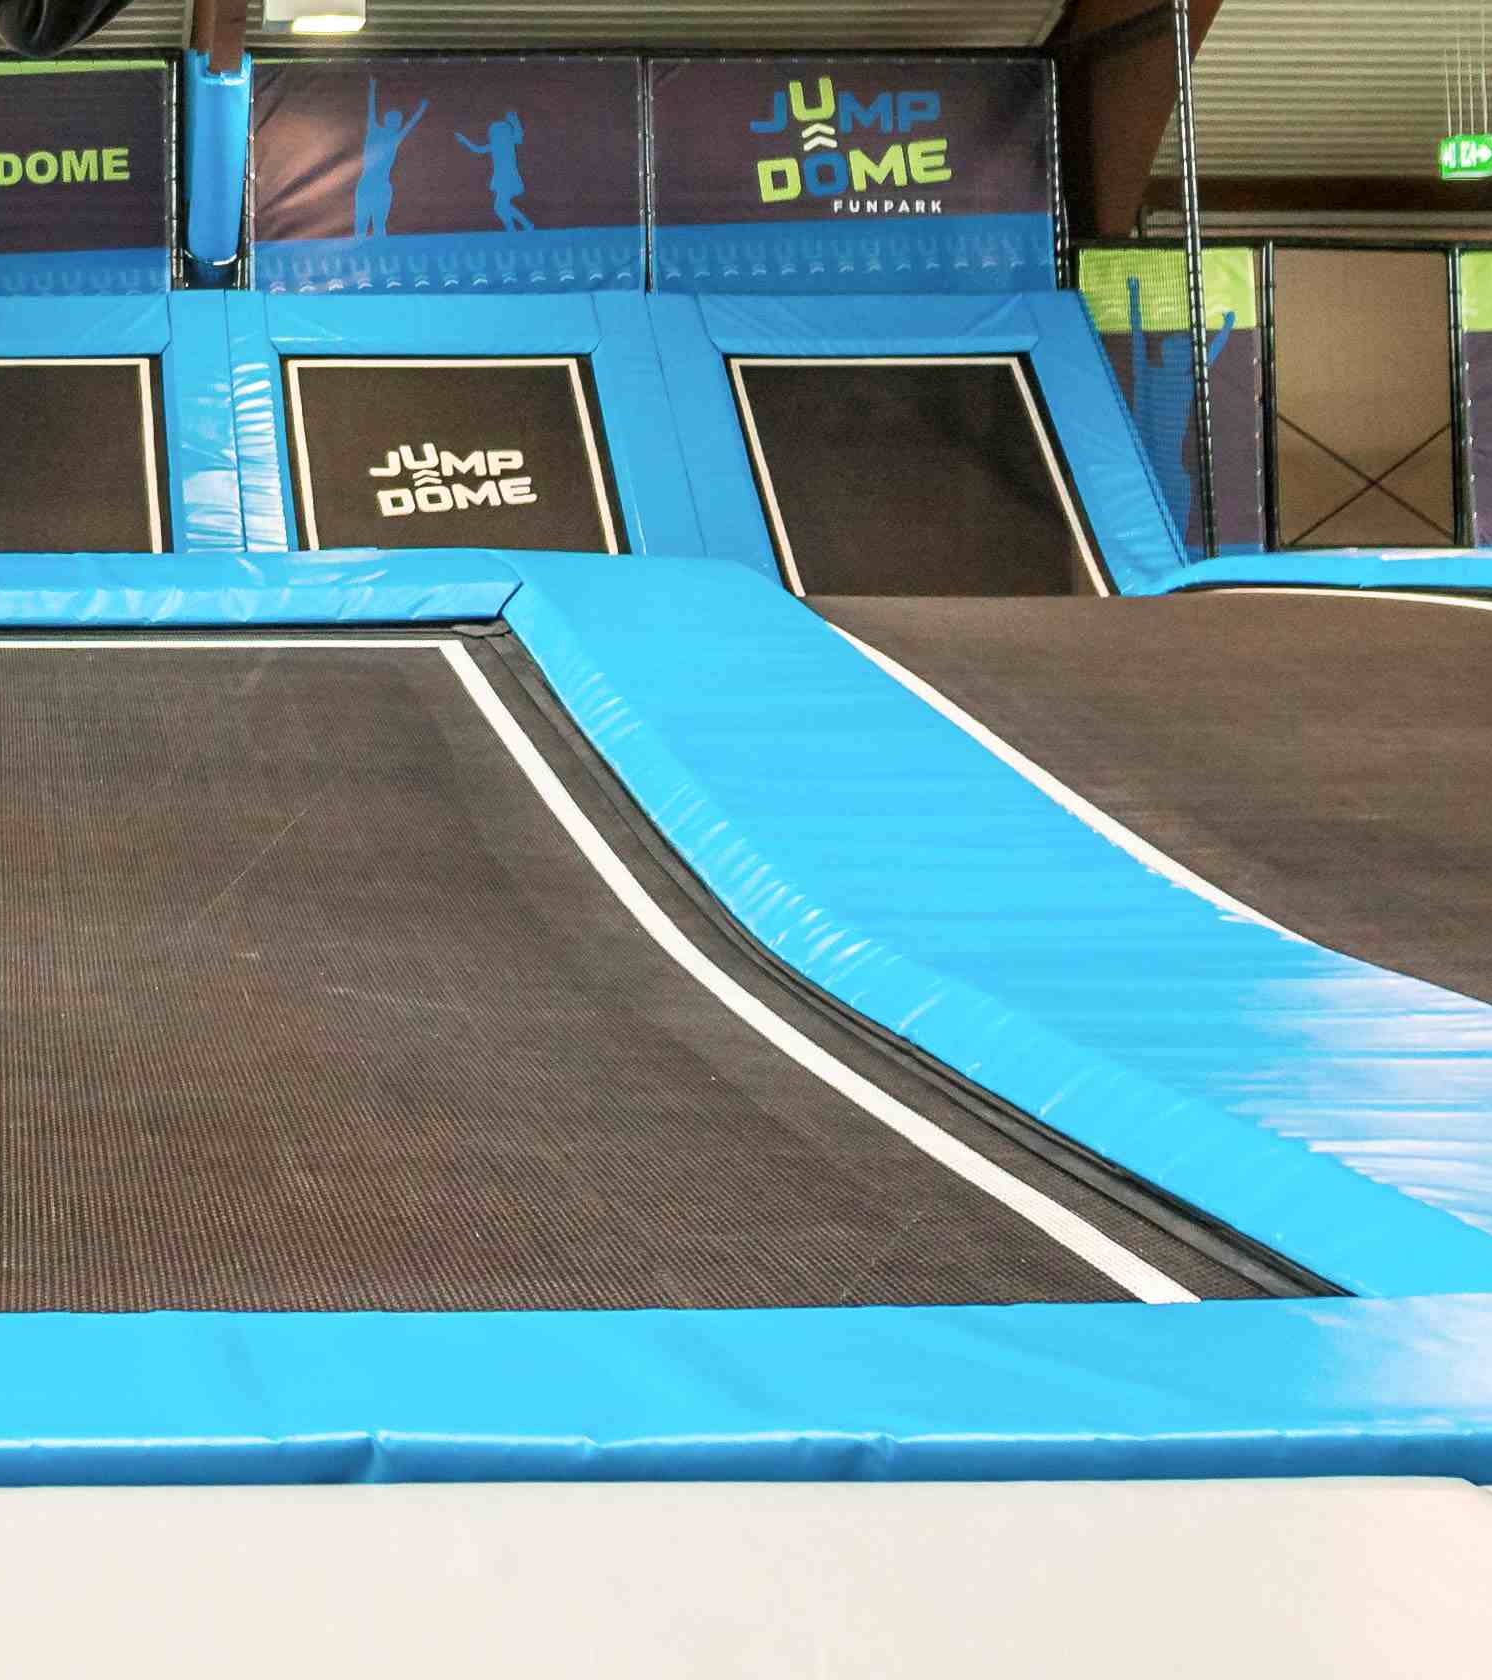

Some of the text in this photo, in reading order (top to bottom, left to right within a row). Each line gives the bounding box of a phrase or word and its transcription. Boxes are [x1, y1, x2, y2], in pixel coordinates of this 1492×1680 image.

[750, 76, 940, 135] JUMP
[758, 138, 951, 203] DOME
[833, 199, 943, 214] FUNPARK
[369, 442, 524, 477] JUMP
[376, 476, 538, 517] DOME
